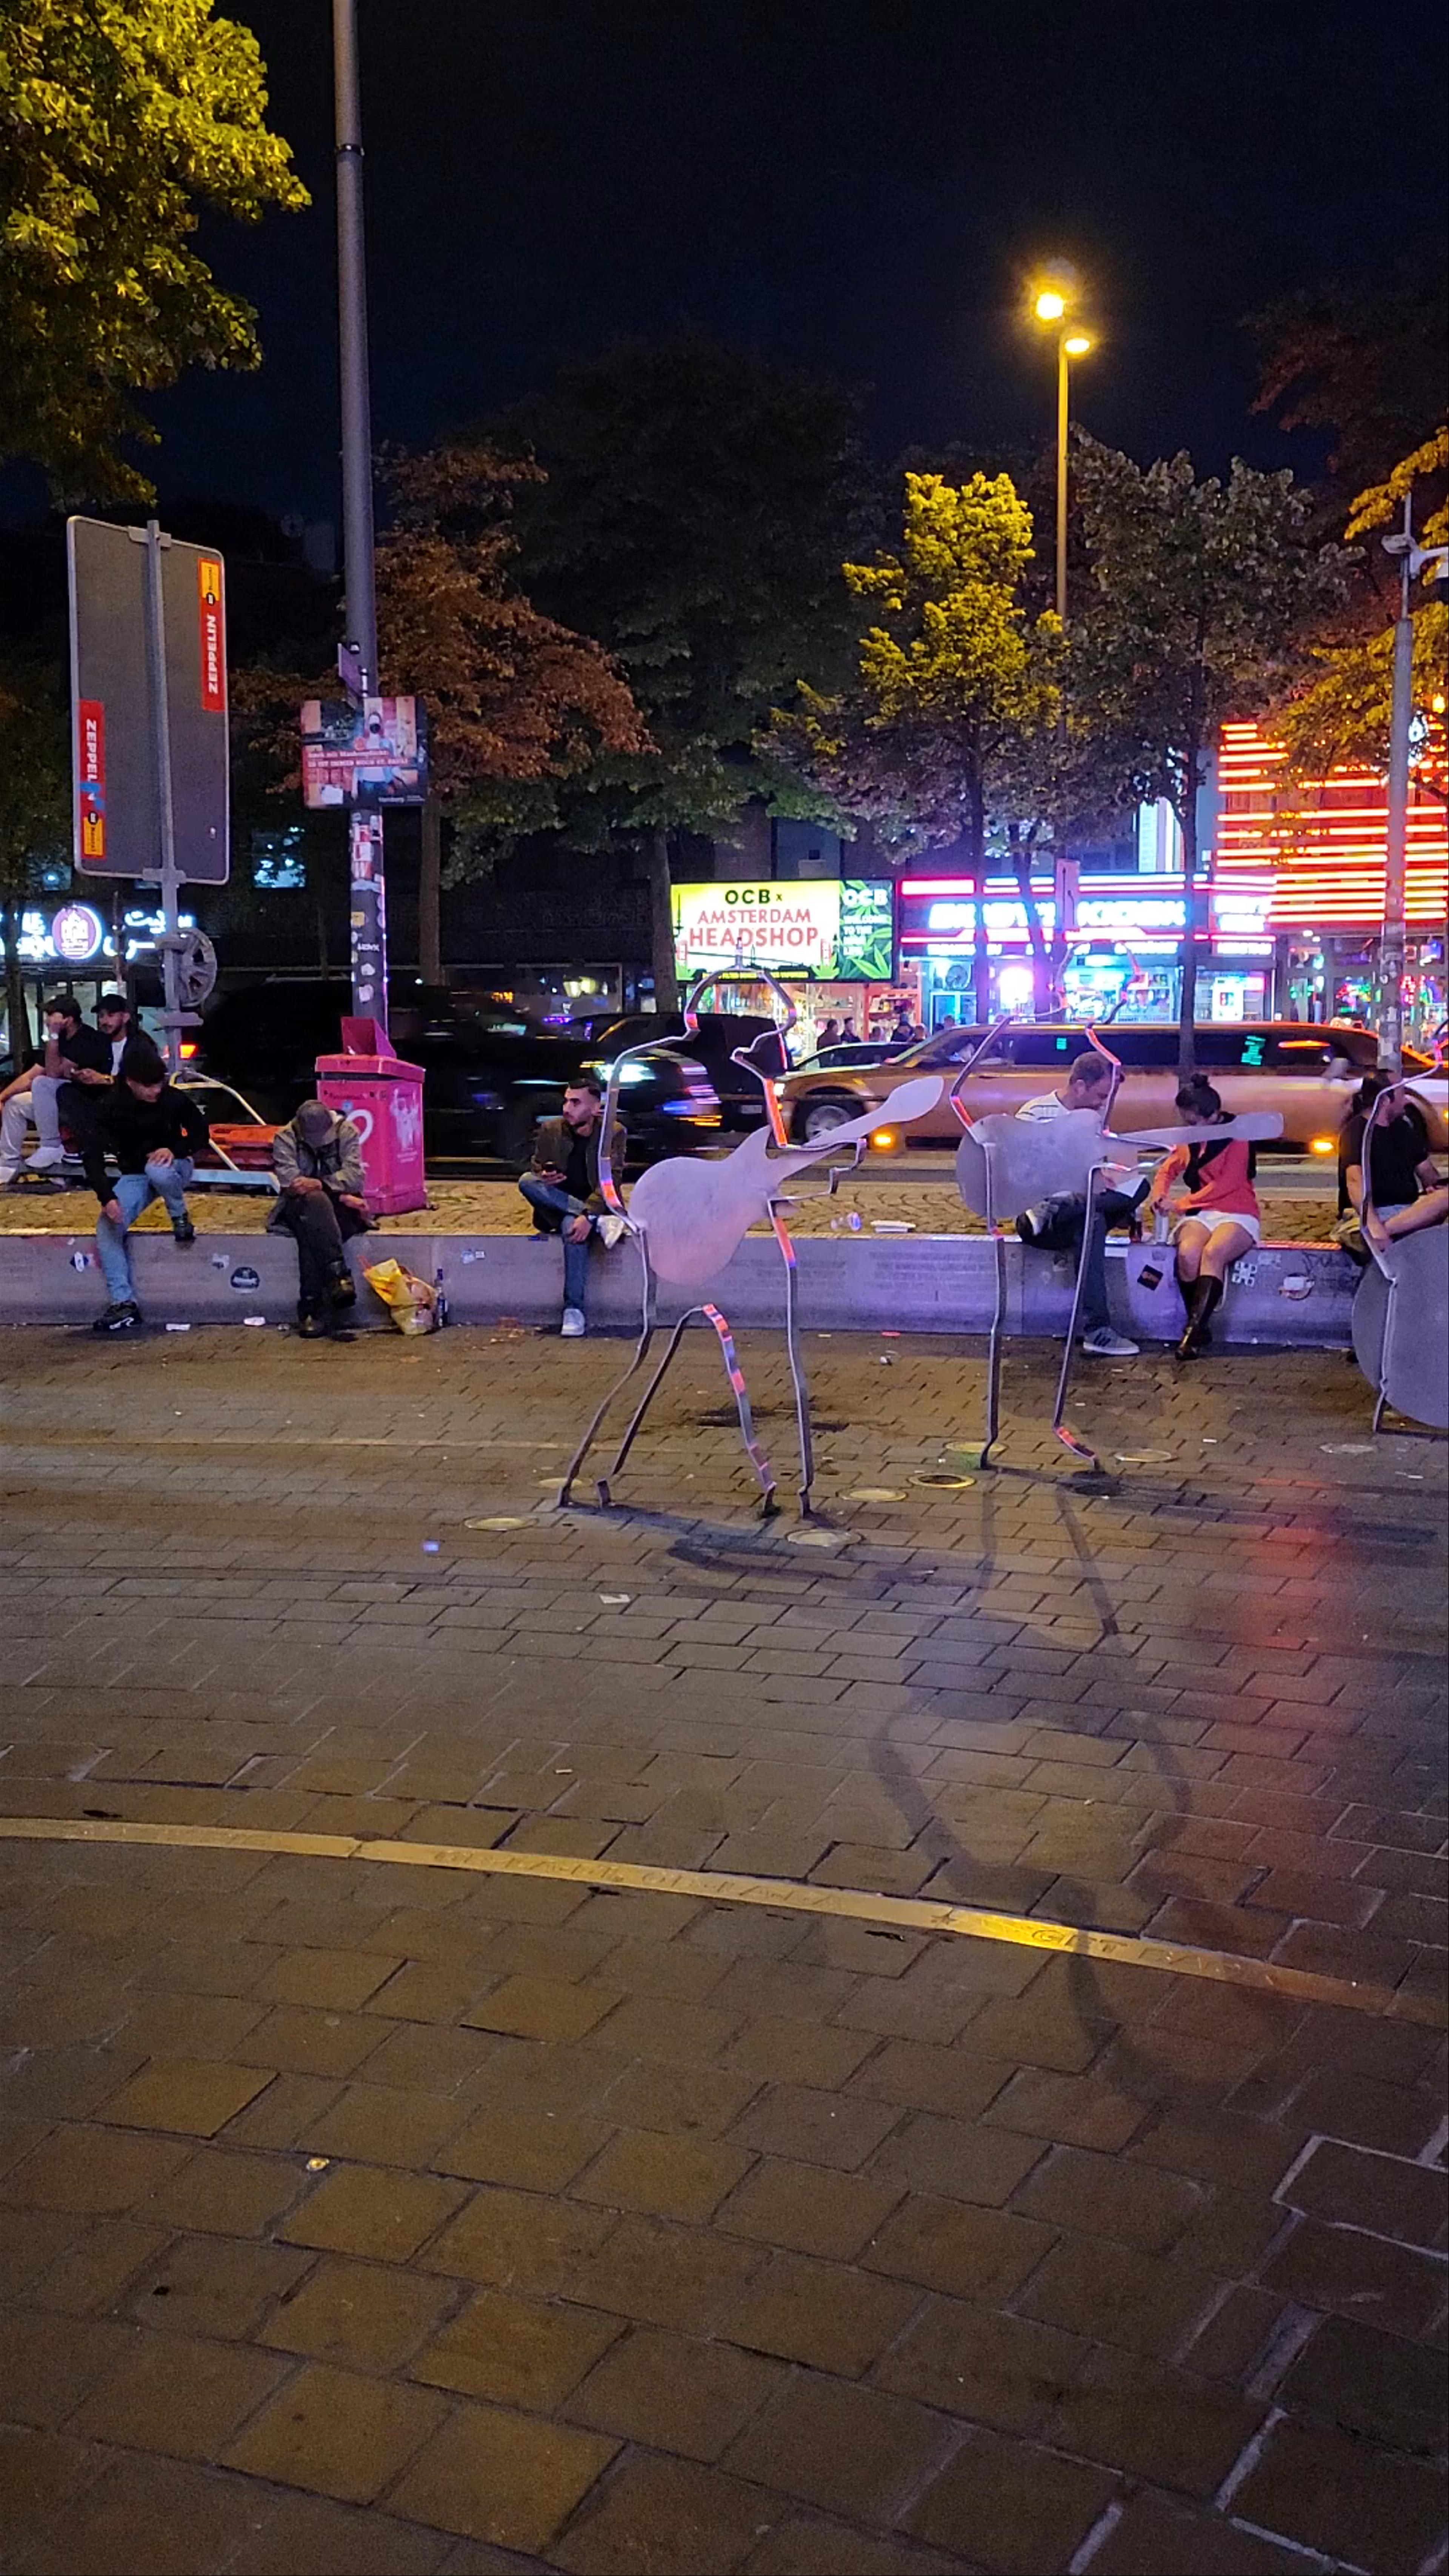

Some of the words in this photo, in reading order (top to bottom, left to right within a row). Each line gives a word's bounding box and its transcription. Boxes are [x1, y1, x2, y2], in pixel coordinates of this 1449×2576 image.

[207, 614, 218, 694] ZEPPELIN
[86, 719, 98, 801] ZEPPEL
[725, 889, 771, 905] OCB
[844, 889, 887, 906] OCB
[697, 908, 811, 924] AMSTERDAM
[689, 927, 818, 947] HEADSHOP
